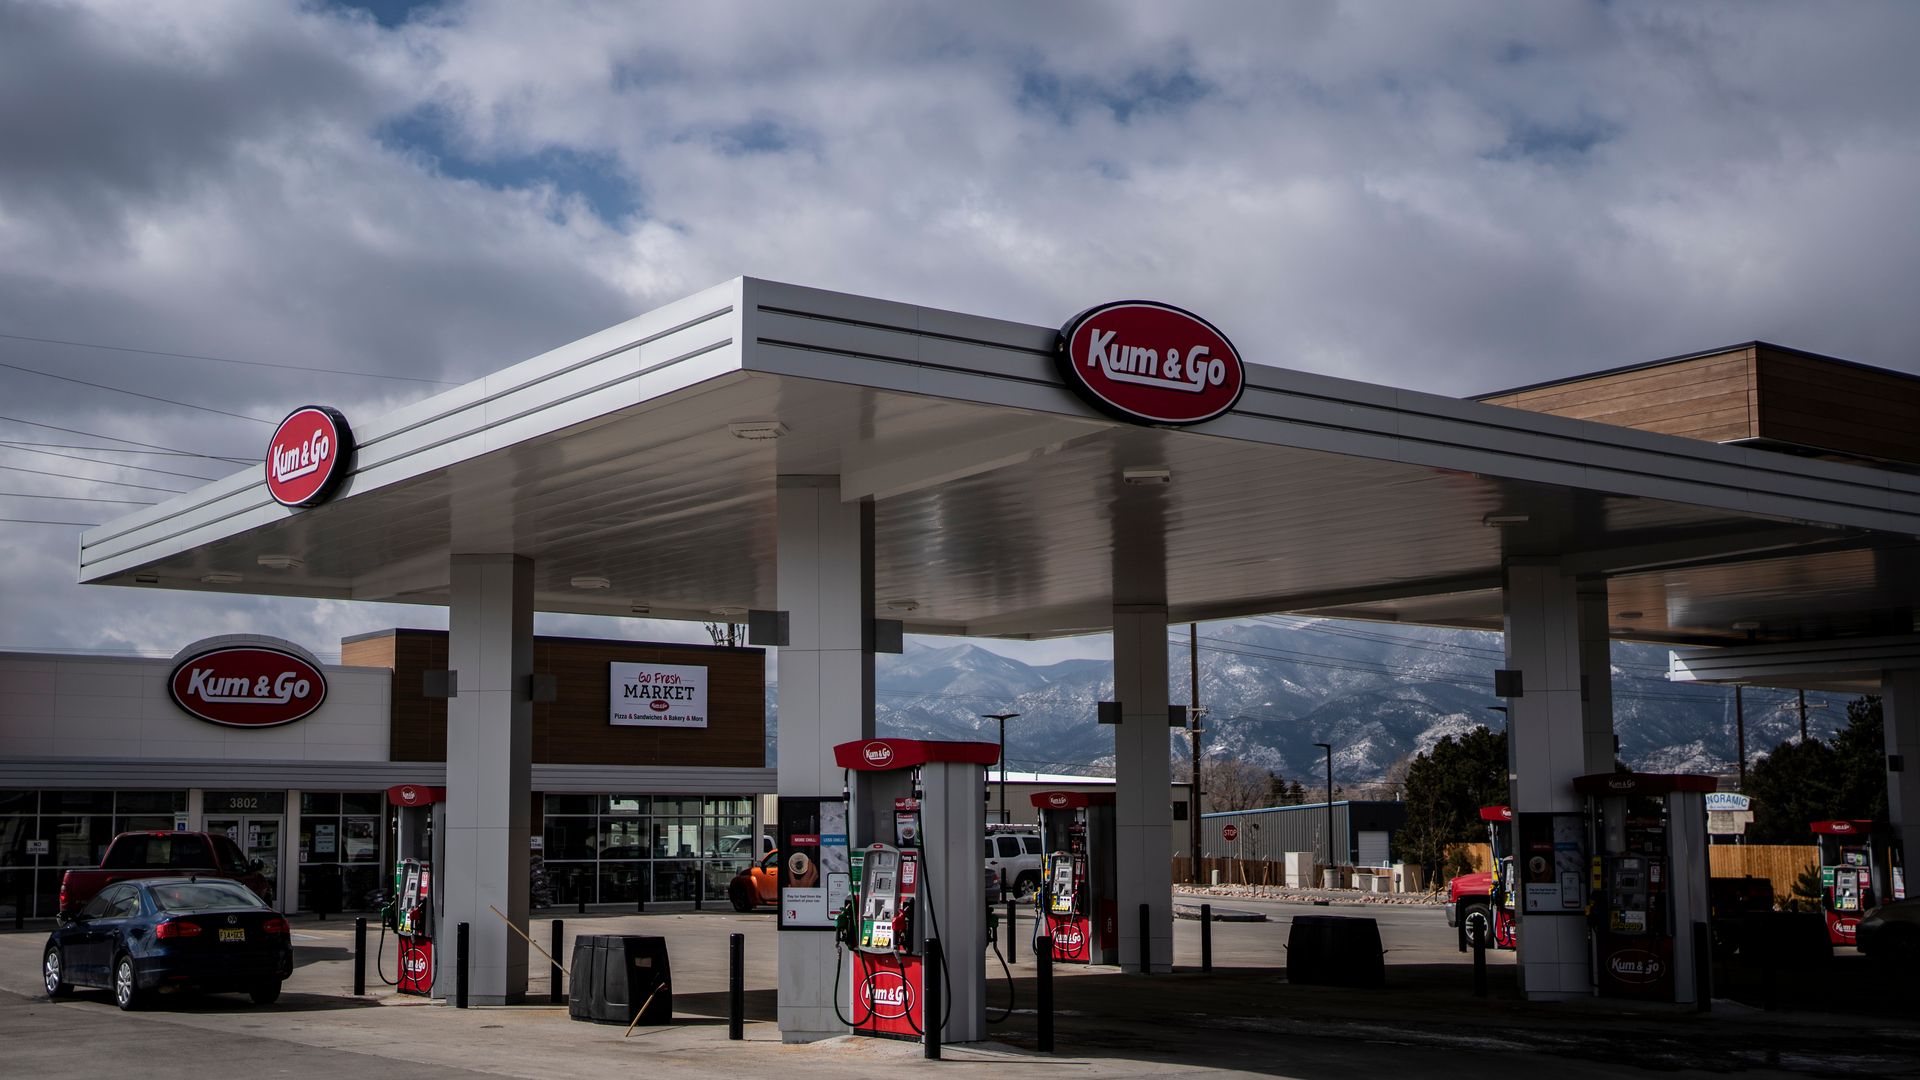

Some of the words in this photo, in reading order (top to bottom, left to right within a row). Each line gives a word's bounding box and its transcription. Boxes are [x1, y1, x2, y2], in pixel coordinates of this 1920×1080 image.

[1087, 328, 1158, 380] Kum
[1163, 348, 1181, 379] &
[1185, 345, 1225, 392] Go
[272, 443, 300, 482] Kum
[301, 440, 310, 466] &
[311, 429, 329, 472] Go
[638, 671, 652, 683] Go
[654, 672, 682, 684] Fresh
[187, 668, 250, 702] Kum
[254, 675, 270, 697] &
[274, 672, 310, 704] Go
[624, 684, 695, 700] MARKET
[633, 713, 662, 721] Sandwiches
[866, 749, 879, 760] Kum
[882, 748, 891, 760] Go
[229, 797, 258, 809] 3802
[1706, 794, 1748, 807] NORAMIC
[1611, 957, 1636, 973] Kum
[1636, 960, 1644, 970] &
[888, 987, 895, 1001] &
